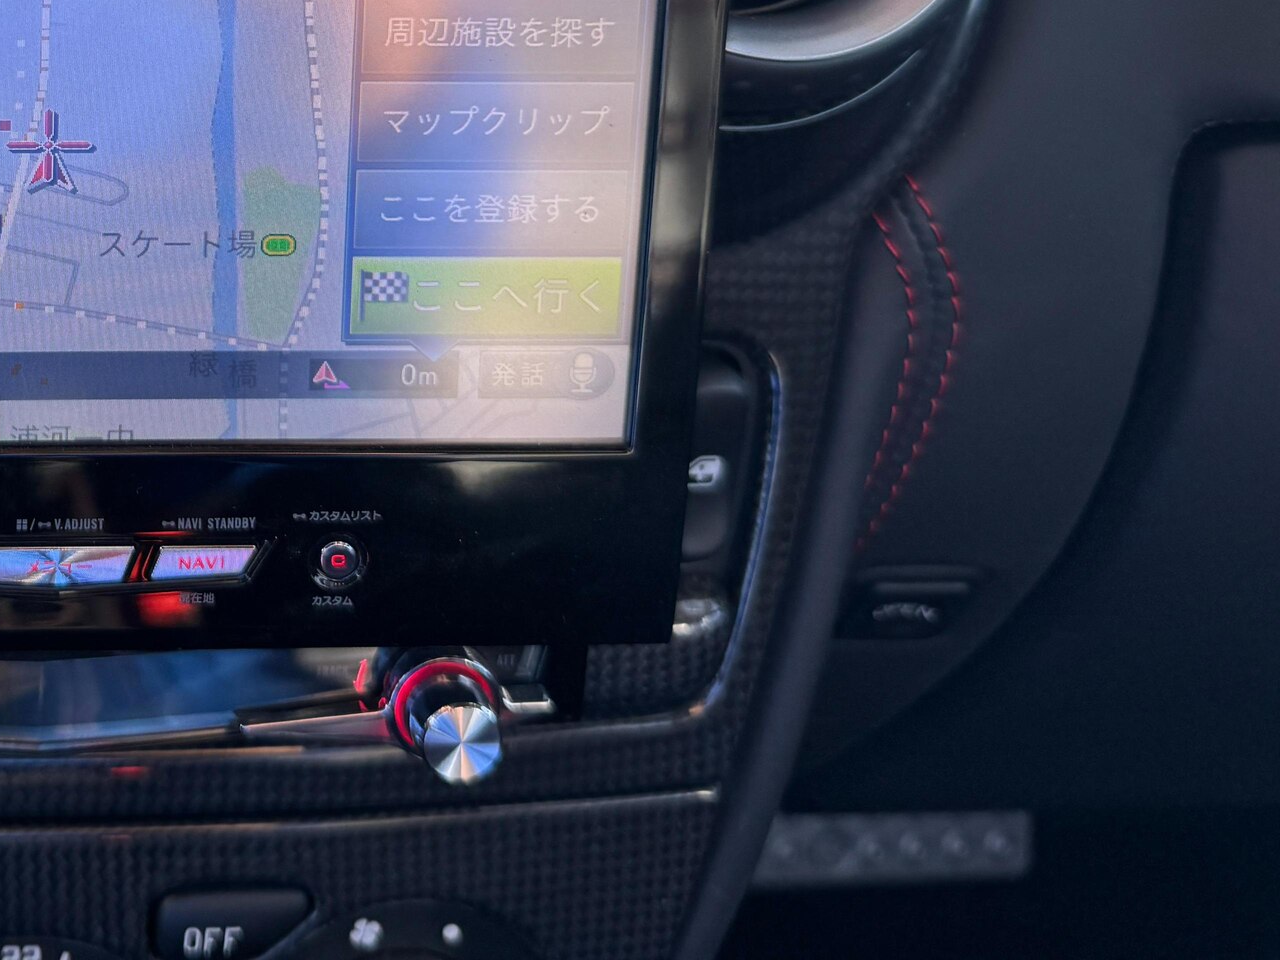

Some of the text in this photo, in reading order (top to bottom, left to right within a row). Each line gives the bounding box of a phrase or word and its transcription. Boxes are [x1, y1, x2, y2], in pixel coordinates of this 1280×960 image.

[384, 16, 616, 48] 周辺施設を探す
[383, 105, 610, 136] マップクリップ
[380, 194, 600, 224] ここを登録する
[99, 230, 256, 260] スケート場
[413, 277, 602, 315] ここへ行く
[400, 362, 438, 386] 0m
[492, 361, 545, 387] 発話
[54, 518, 104, 530] V.ADJUST
[177, 516, 256, 530] NAVI STANDBY
[309, 510, 382, 522] カスタムリスト
[177, 556, 226, 571] NAVI
[311, 595, 354, 607] カスタム
[182, 926, 244, 960] OFF
